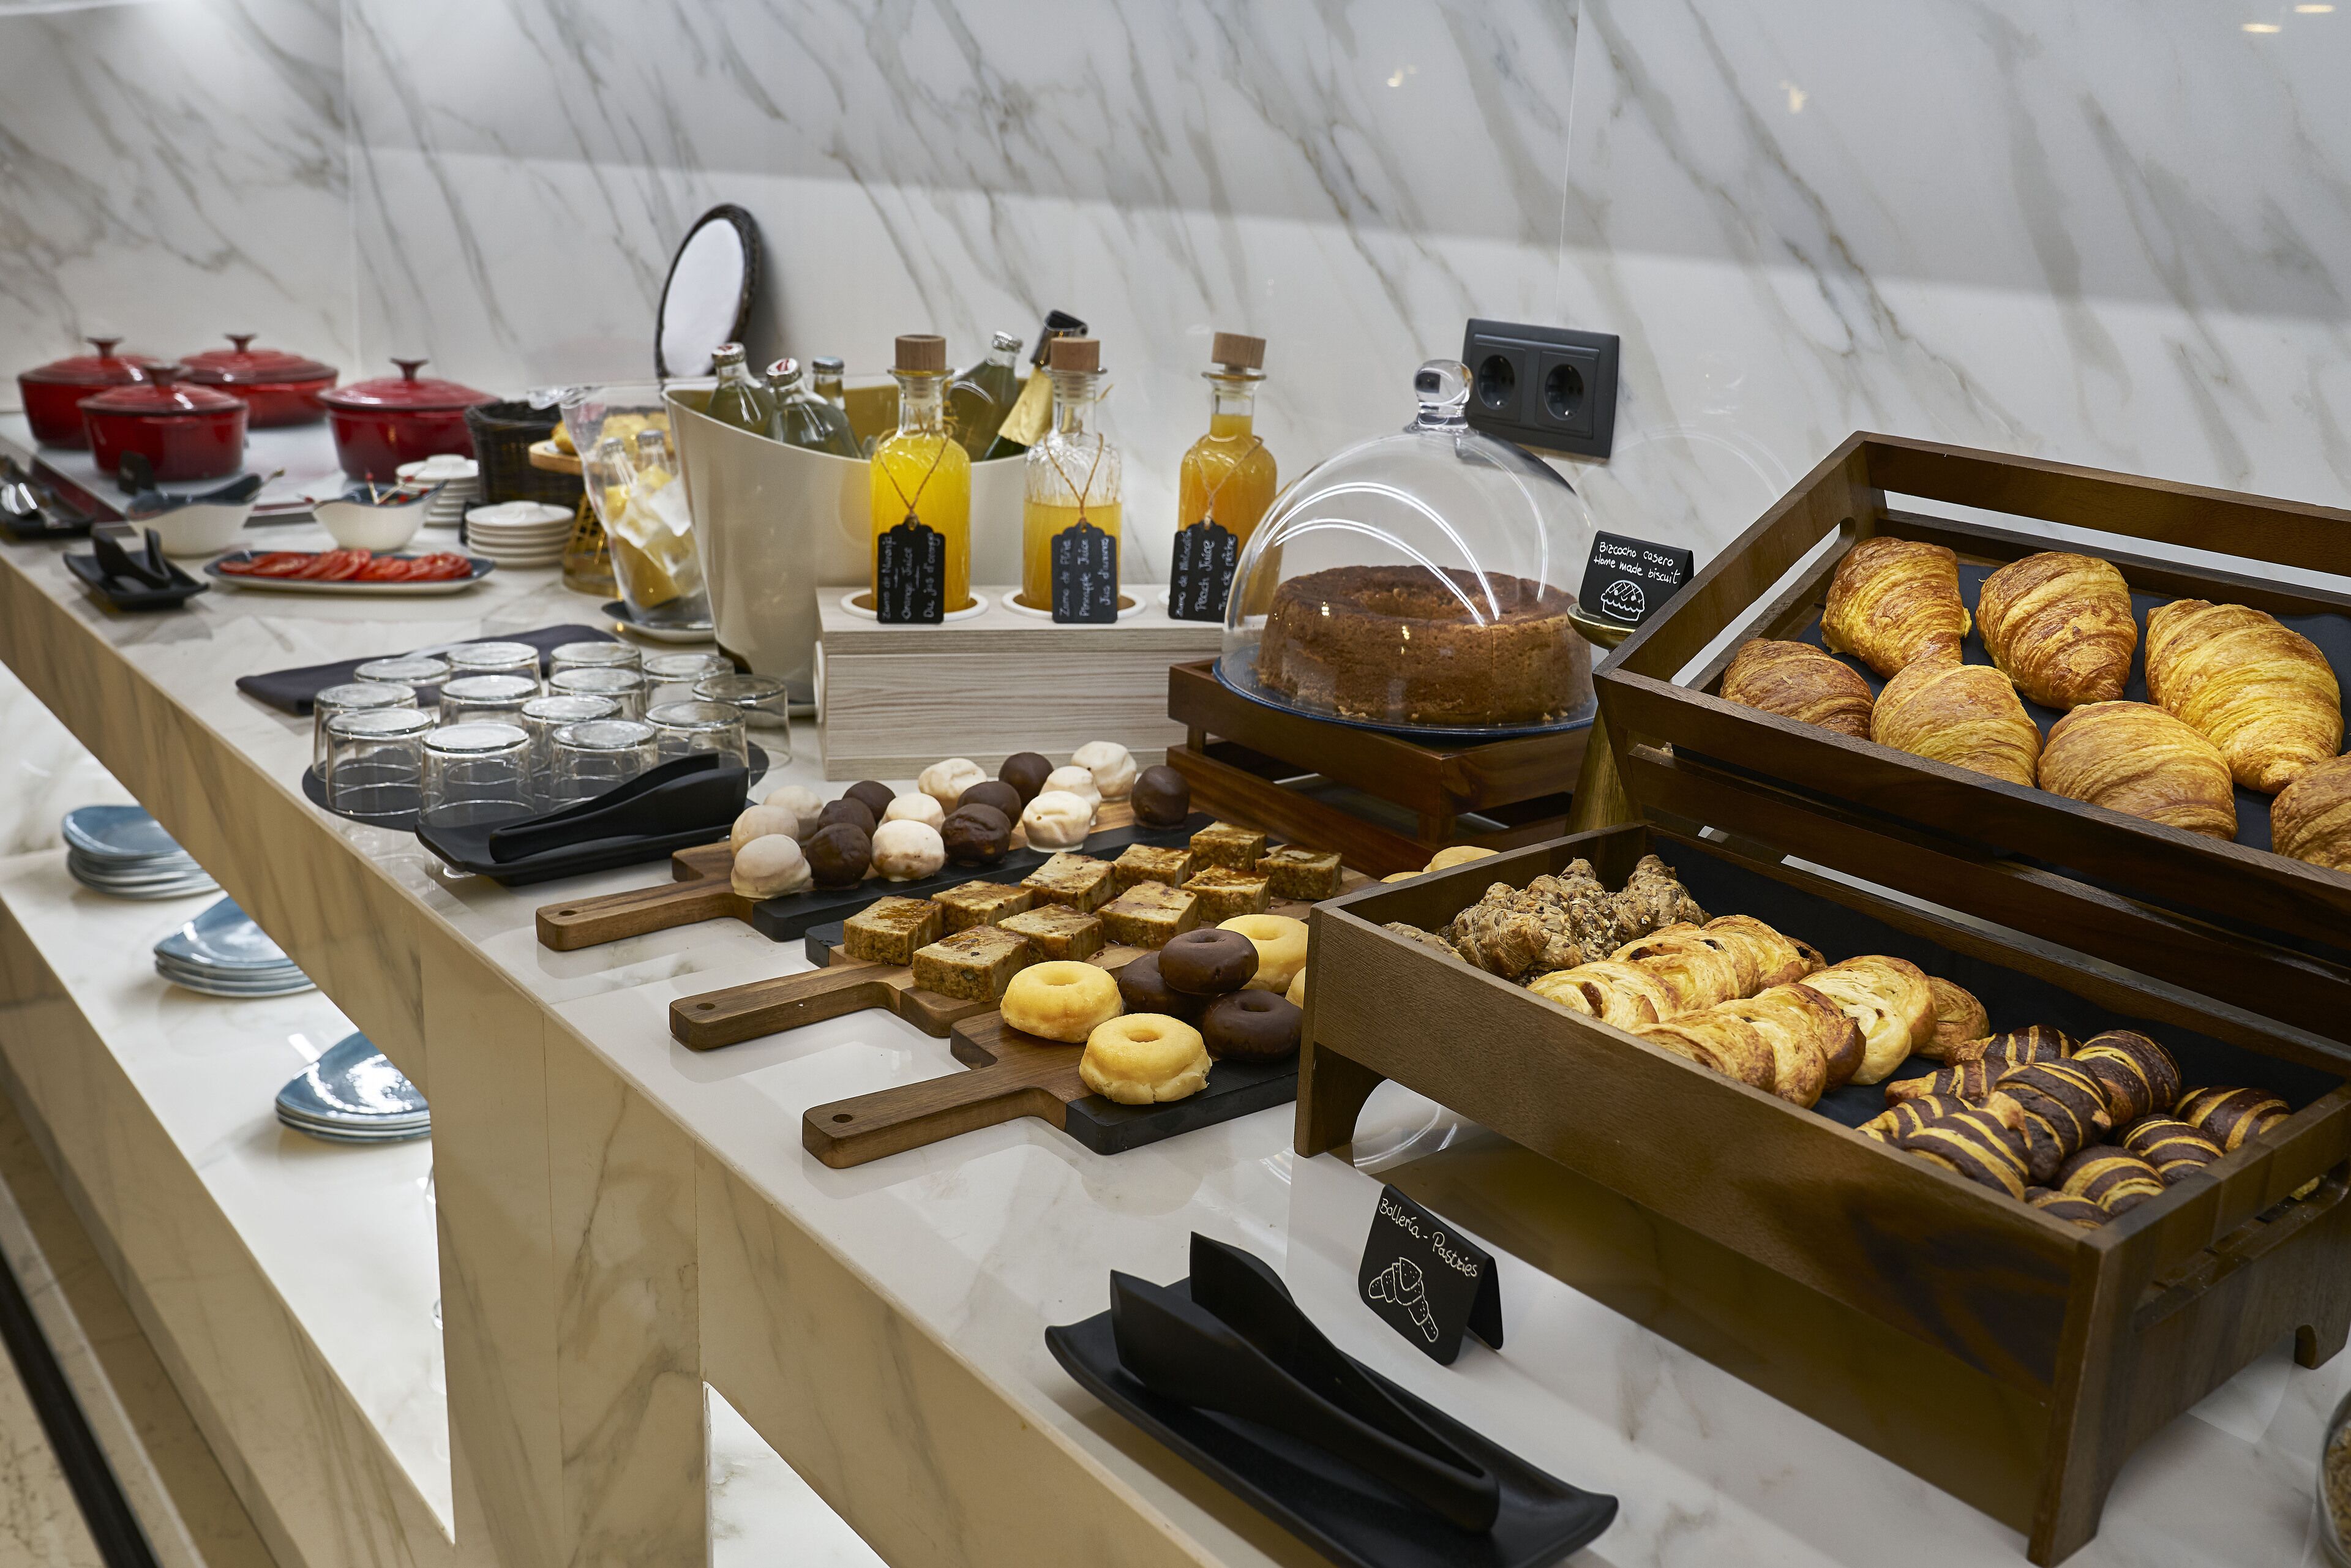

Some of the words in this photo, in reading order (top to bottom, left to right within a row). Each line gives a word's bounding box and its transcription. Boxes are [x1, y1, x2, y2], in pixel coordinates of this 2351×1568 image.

[901, 547, 912, 576] Juice
[1078, 539, 1089, 565] Juice
[1198, 540, 1215, 571] Juice
[1599, 541, 1637, 558] Bizcocho
[1643, 550, 1674, 566] casero
[1060, 571, 1070, 584] de
[1178, 576, 1188, 588] de
[1221, 571, 1231, 586] de
[1594, 554, 1616, 568] Home
[1619, 561, 1643, 576] made
[1648, 568, 1681, 584] biscuit
[901, 583, 915, 620] Orange
[1059, 588, 1070, 617] Zumo
[1079, 572, 1094, 617] Pineapple
[1099, 585, 1111, 606] Jus
[1194, 577, 1210, 612] Peach
[1379, 1198, 1420, 1239] Bollería
[1432, 1231, 1477, 1278] Pastries
